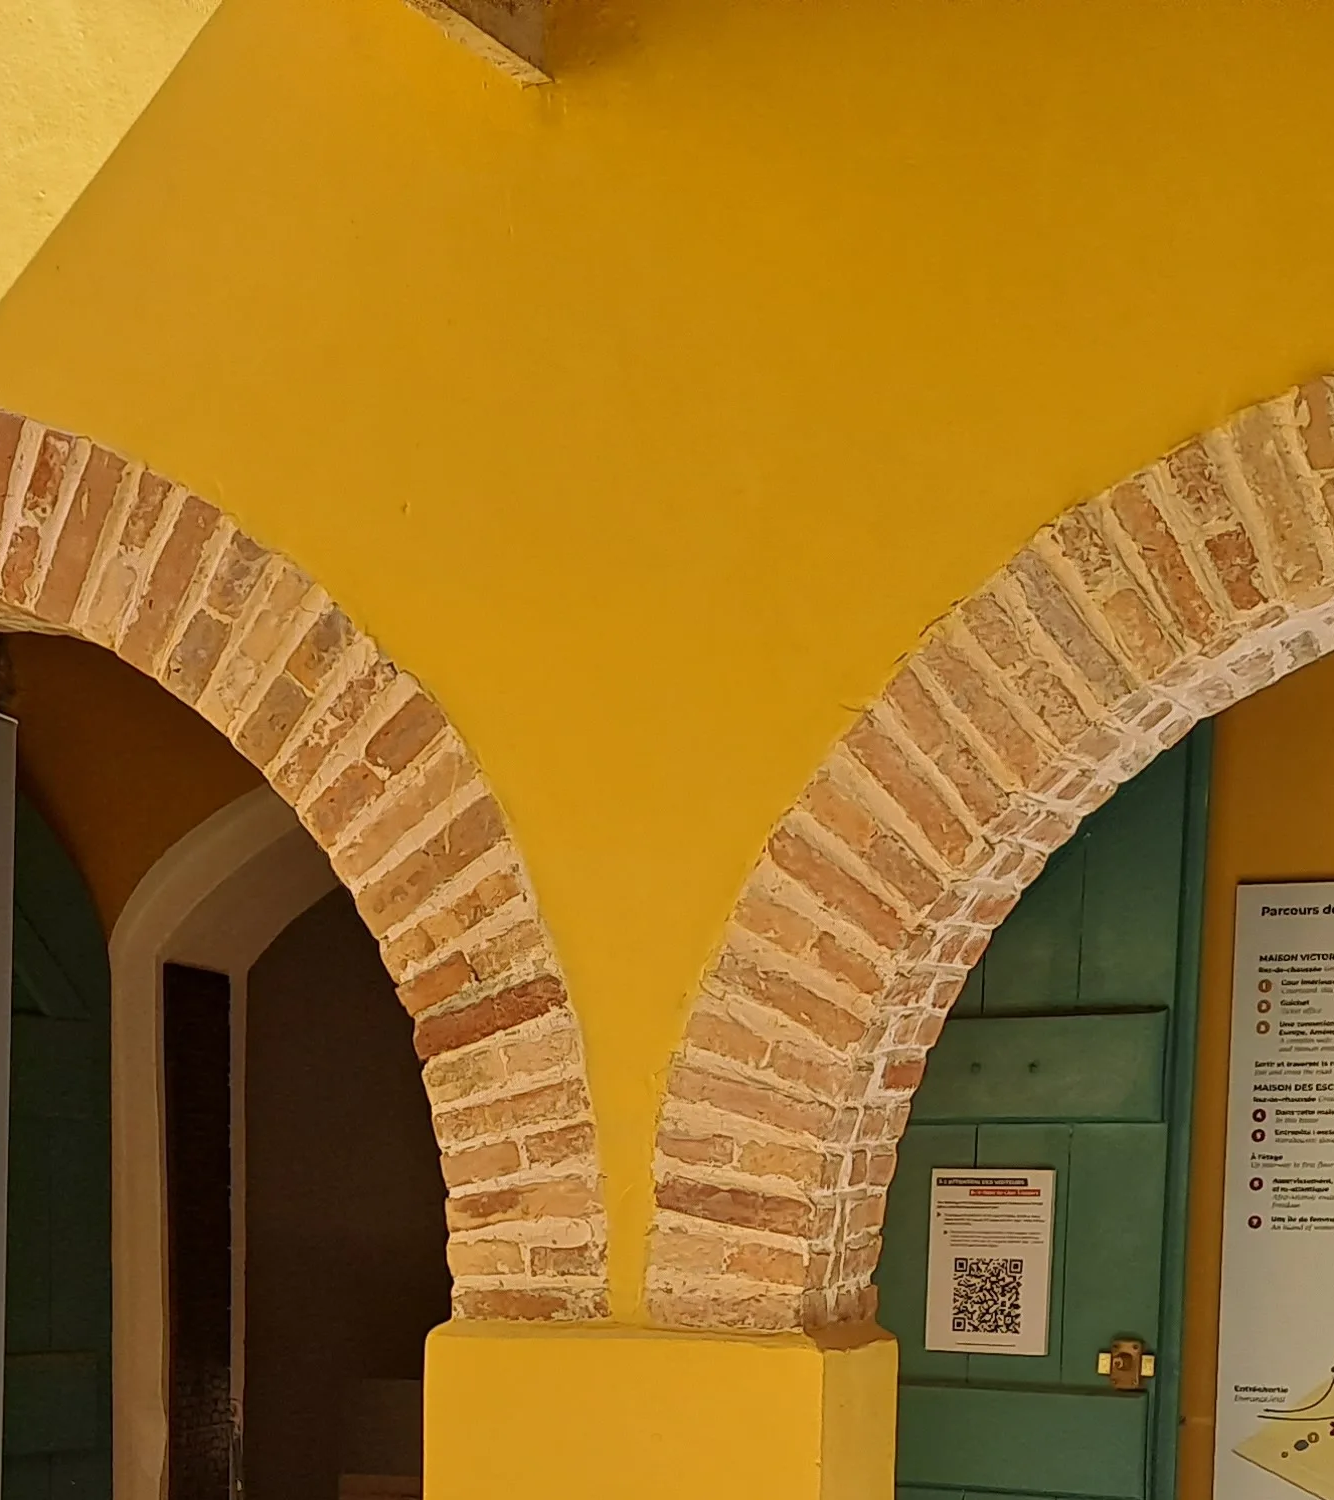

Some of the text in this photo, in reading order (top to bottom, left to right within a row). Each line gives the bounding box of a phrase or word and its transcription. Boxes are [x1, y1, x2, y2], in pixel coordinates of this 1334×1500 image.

[1261, 906, 1320, 917] Parcours
[1259, 954, 1298, 962] MAISON
[1295, 1083, 1314, 1091] DES
